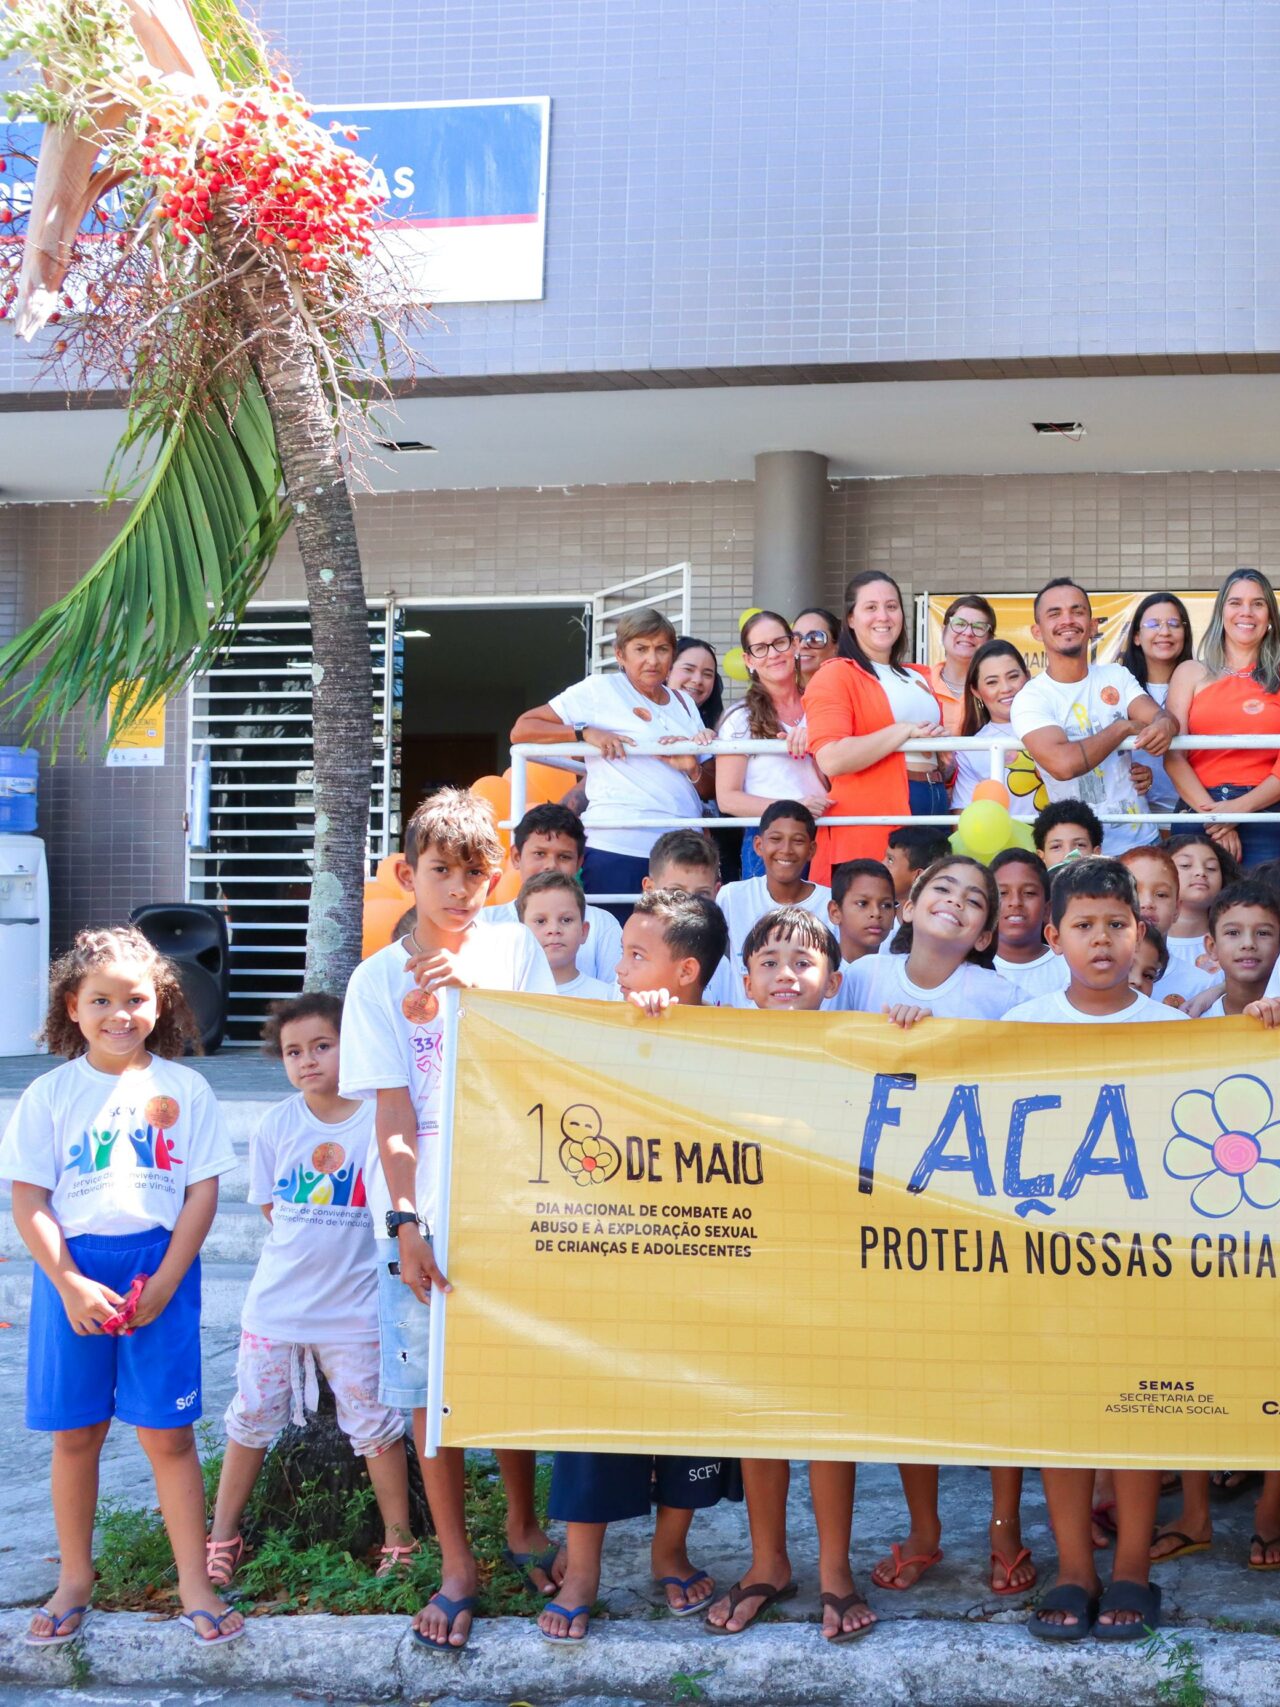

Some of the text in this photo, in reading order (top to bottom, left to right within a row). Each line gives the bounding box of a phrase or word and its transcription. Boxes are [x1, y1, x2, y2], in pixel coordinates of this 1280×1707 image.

[858, 1073, 1149, 1219] FAÇA
[626, 1136, 663, 1183] DE
[674, 1141, 764, 1186] MAIO
[536, 1202, 752, 1220] DIA NACIONAL DE COMBATE AO
[530, 1219, 758, 1240] ABUSO E À EXPLORAÇÃO SEXUAL
[535, 1240, 752, 1258] DE CRIANÇAS E ADOLESCENTES
[860, 1226, 1009, 1274] PROTEJA
[1025, 1231, 1172, 1278] NOSSAS
[1138, 1380, 1195, 1391] SEMAS
[1119, 1393, 1214, 1403] SECRETARIA DE
[1105, 1403, 1229, 1415] ASSISTÊNCIA SOCIAL
[689, 1462, 721, 1482] SCFV
